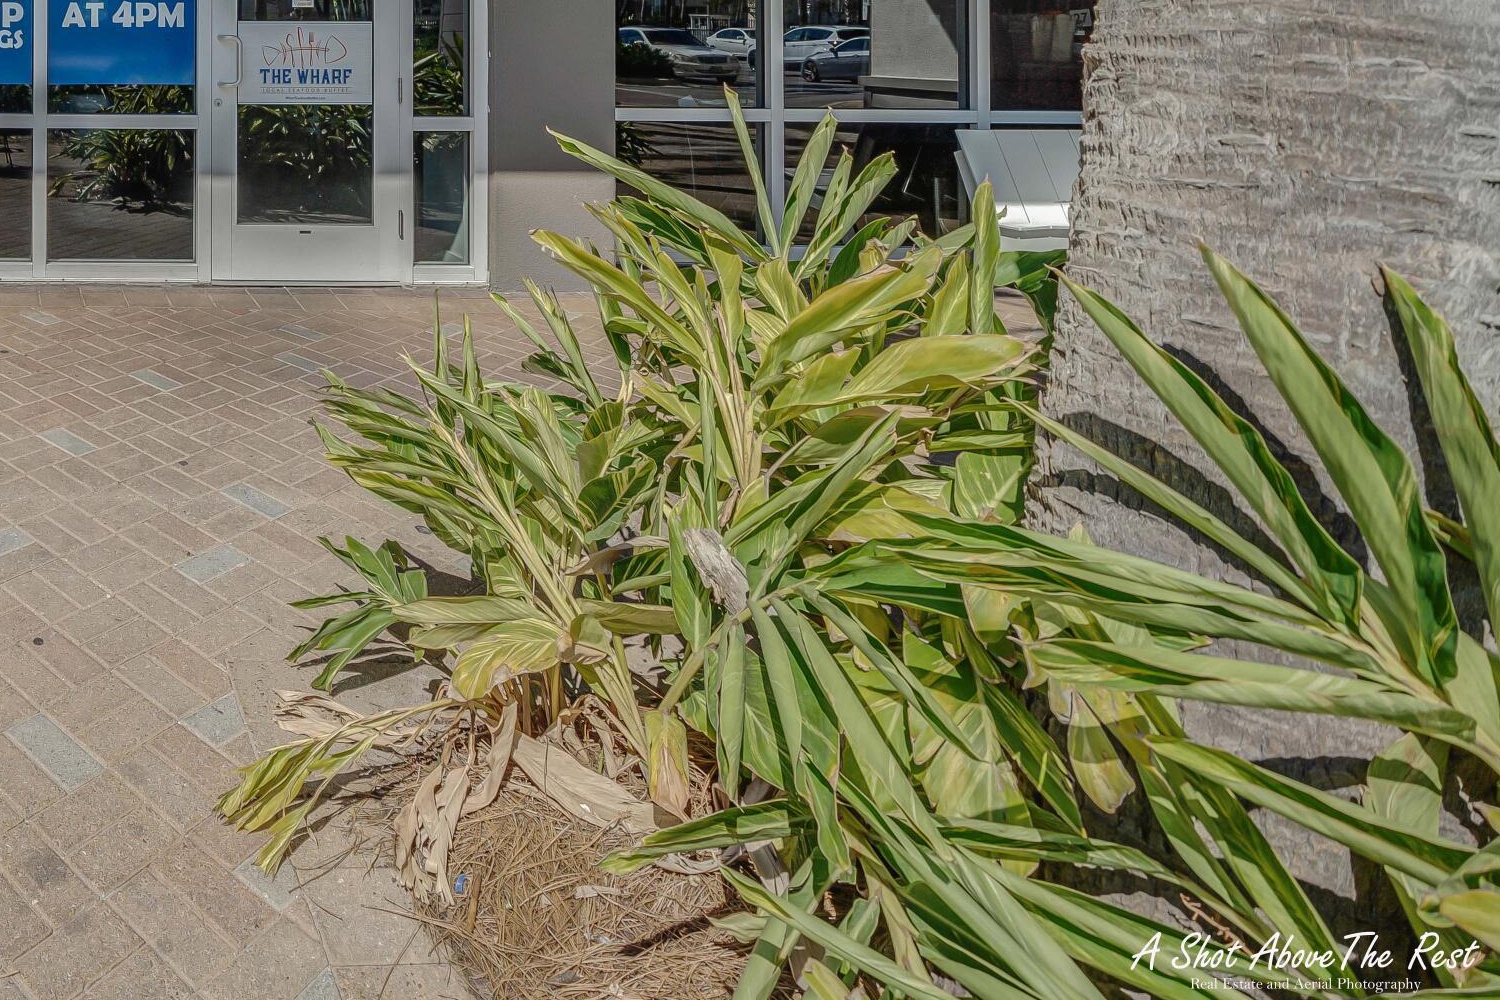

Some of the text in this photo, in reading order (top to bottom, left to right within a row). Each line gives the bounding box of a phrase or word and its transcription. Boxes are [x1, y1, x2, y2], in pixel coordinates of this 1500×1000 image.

[61, 0, 185, 28] AT 4PM
[260, 68, 352, 84] THE WHARF
